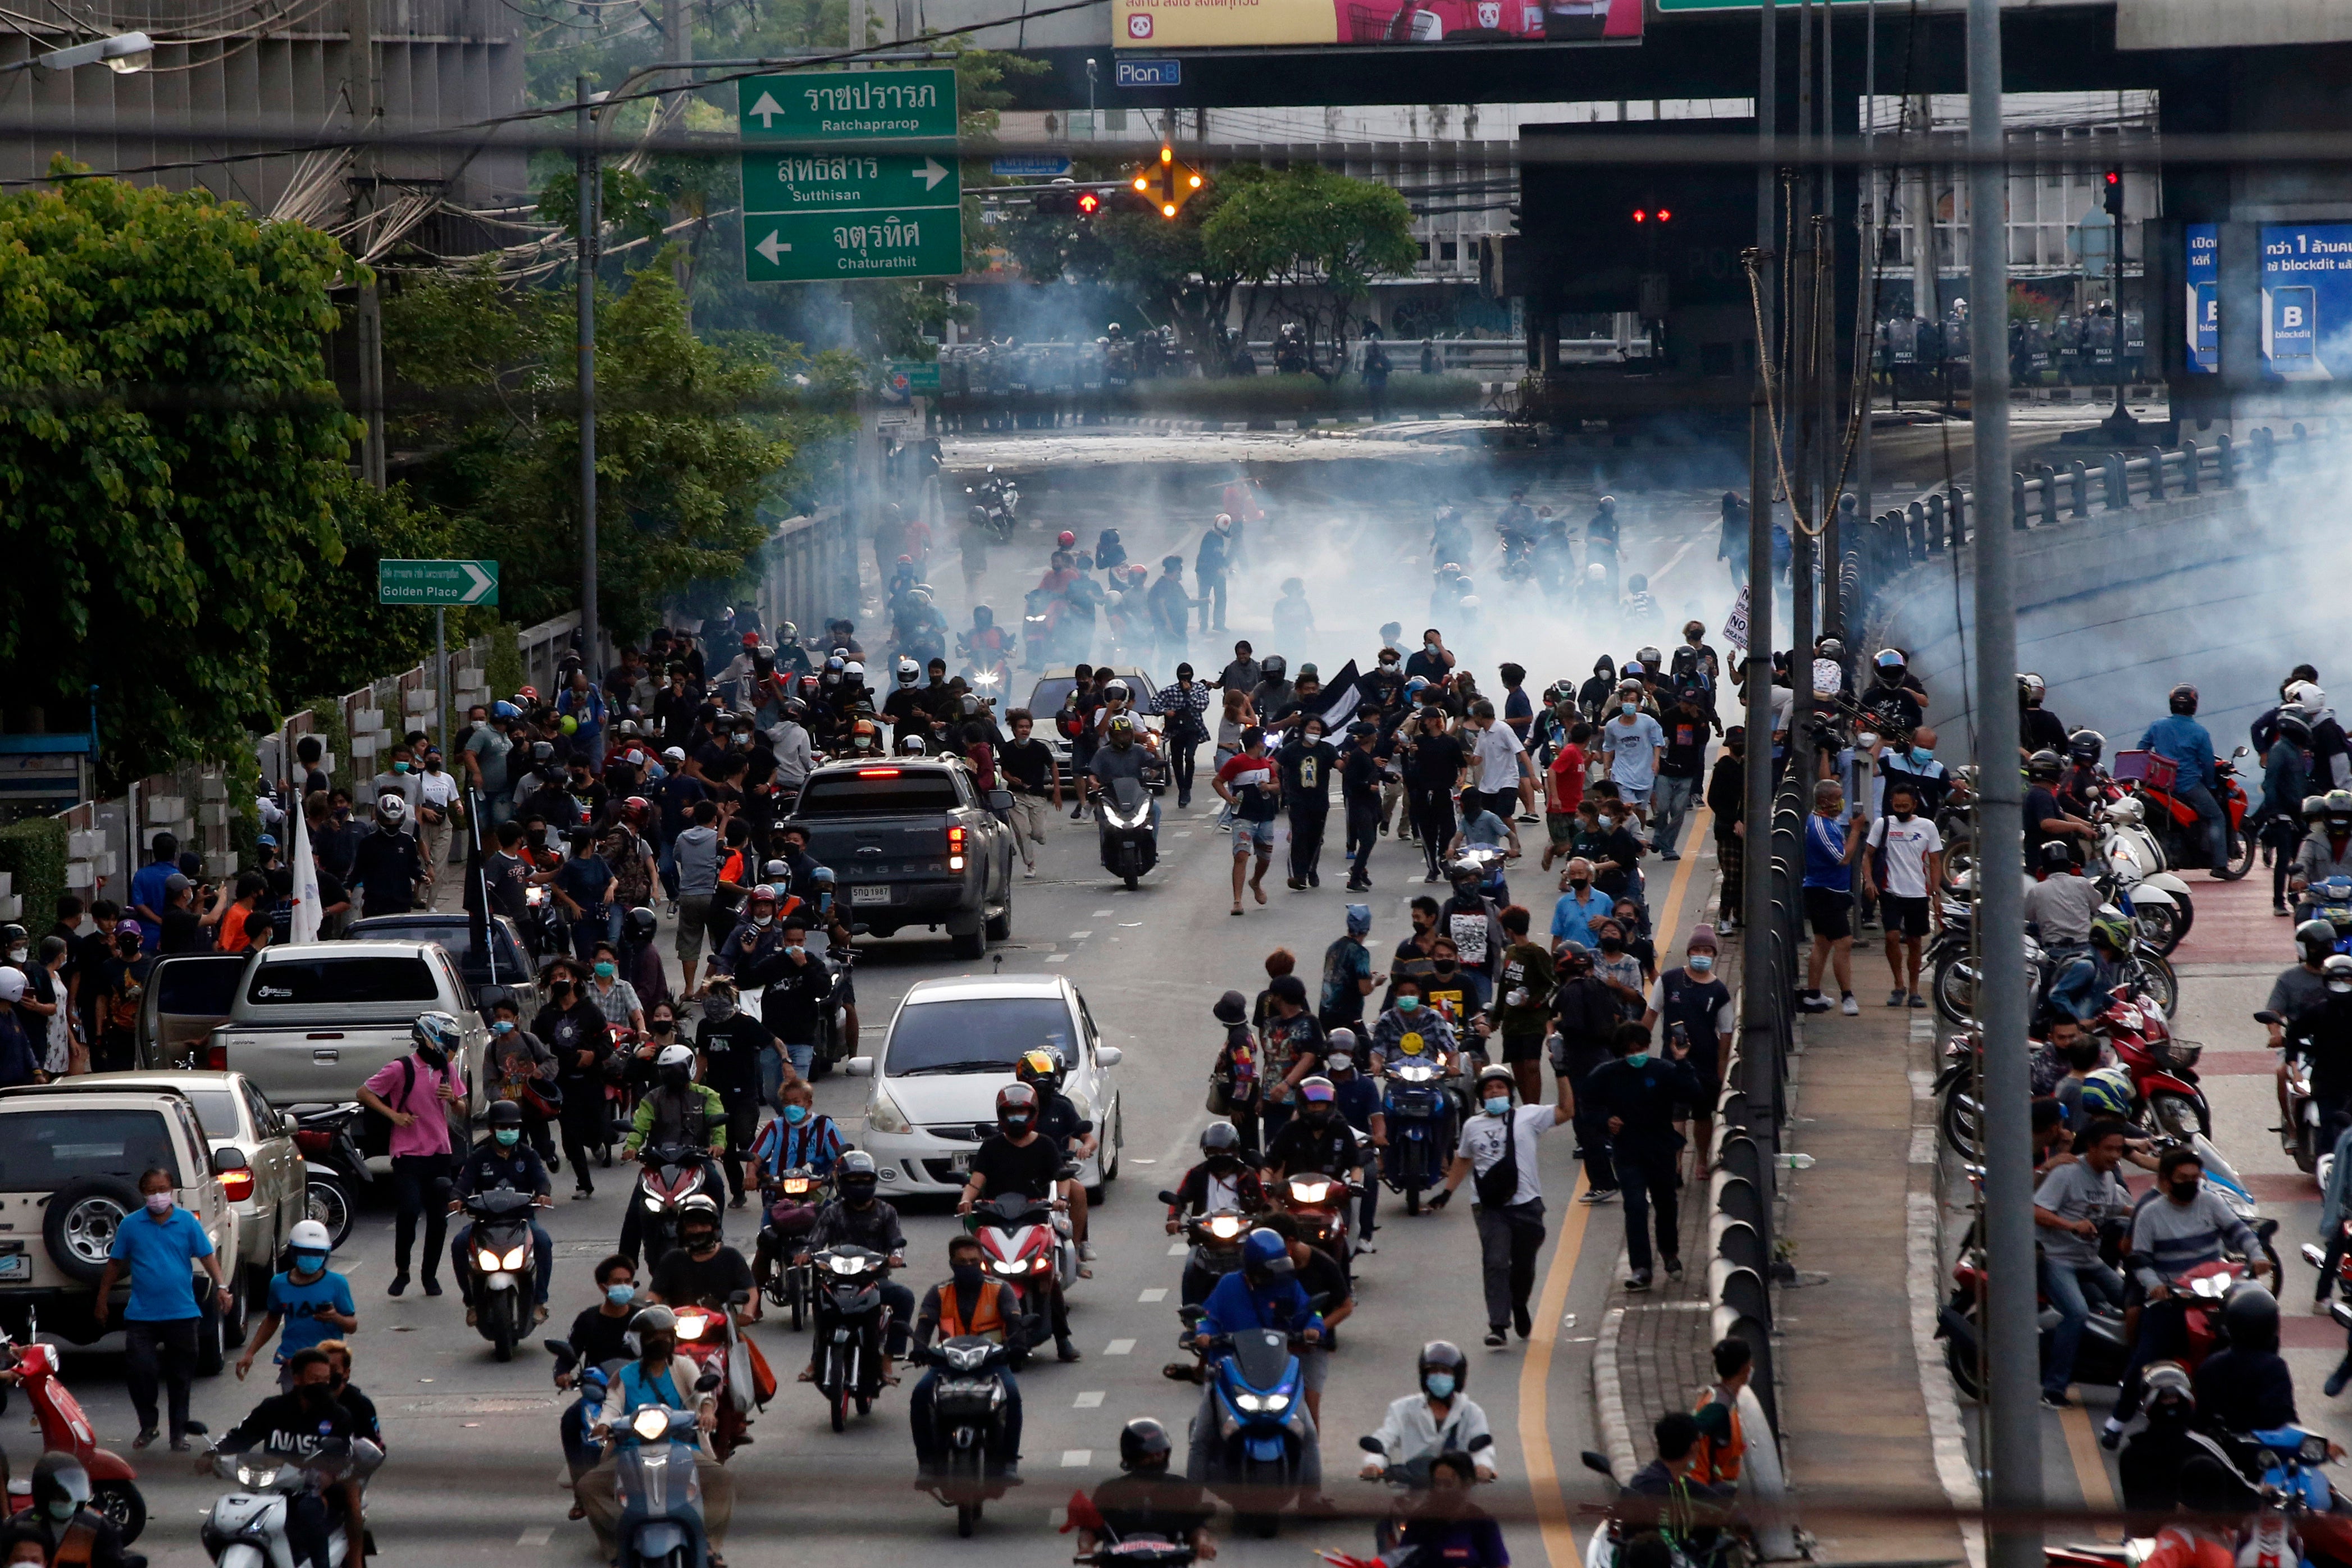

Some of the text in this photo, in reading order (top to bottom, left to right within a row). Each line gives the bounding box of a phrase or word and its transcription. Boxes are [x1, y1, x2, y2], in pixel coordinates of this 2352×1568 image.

[804, 82, 936, 112] ราชปรารภ
[822, 118, 919, 133] Ratchaprarop
[792, 190, 861, 202] Sutthisan
[833, 216, 920, 256] จตุรทิศ
[2267, 241, 2292, 255] กว่า
[2297, 234, 2307, 254] 1
[837, 257, 917, 270] Chaturathit
[2282, 259, 2335, 271] blockdit
[2283, 307, 2303, 328] B
[2275, 330, 2311, 339] blockdit
[382, 586, 458, 597] Golden Place
[1730, 615, 1746, 631] NO
[872, 887, 888, 896] 1987
[270, 1429, 319, 1455] NAS
